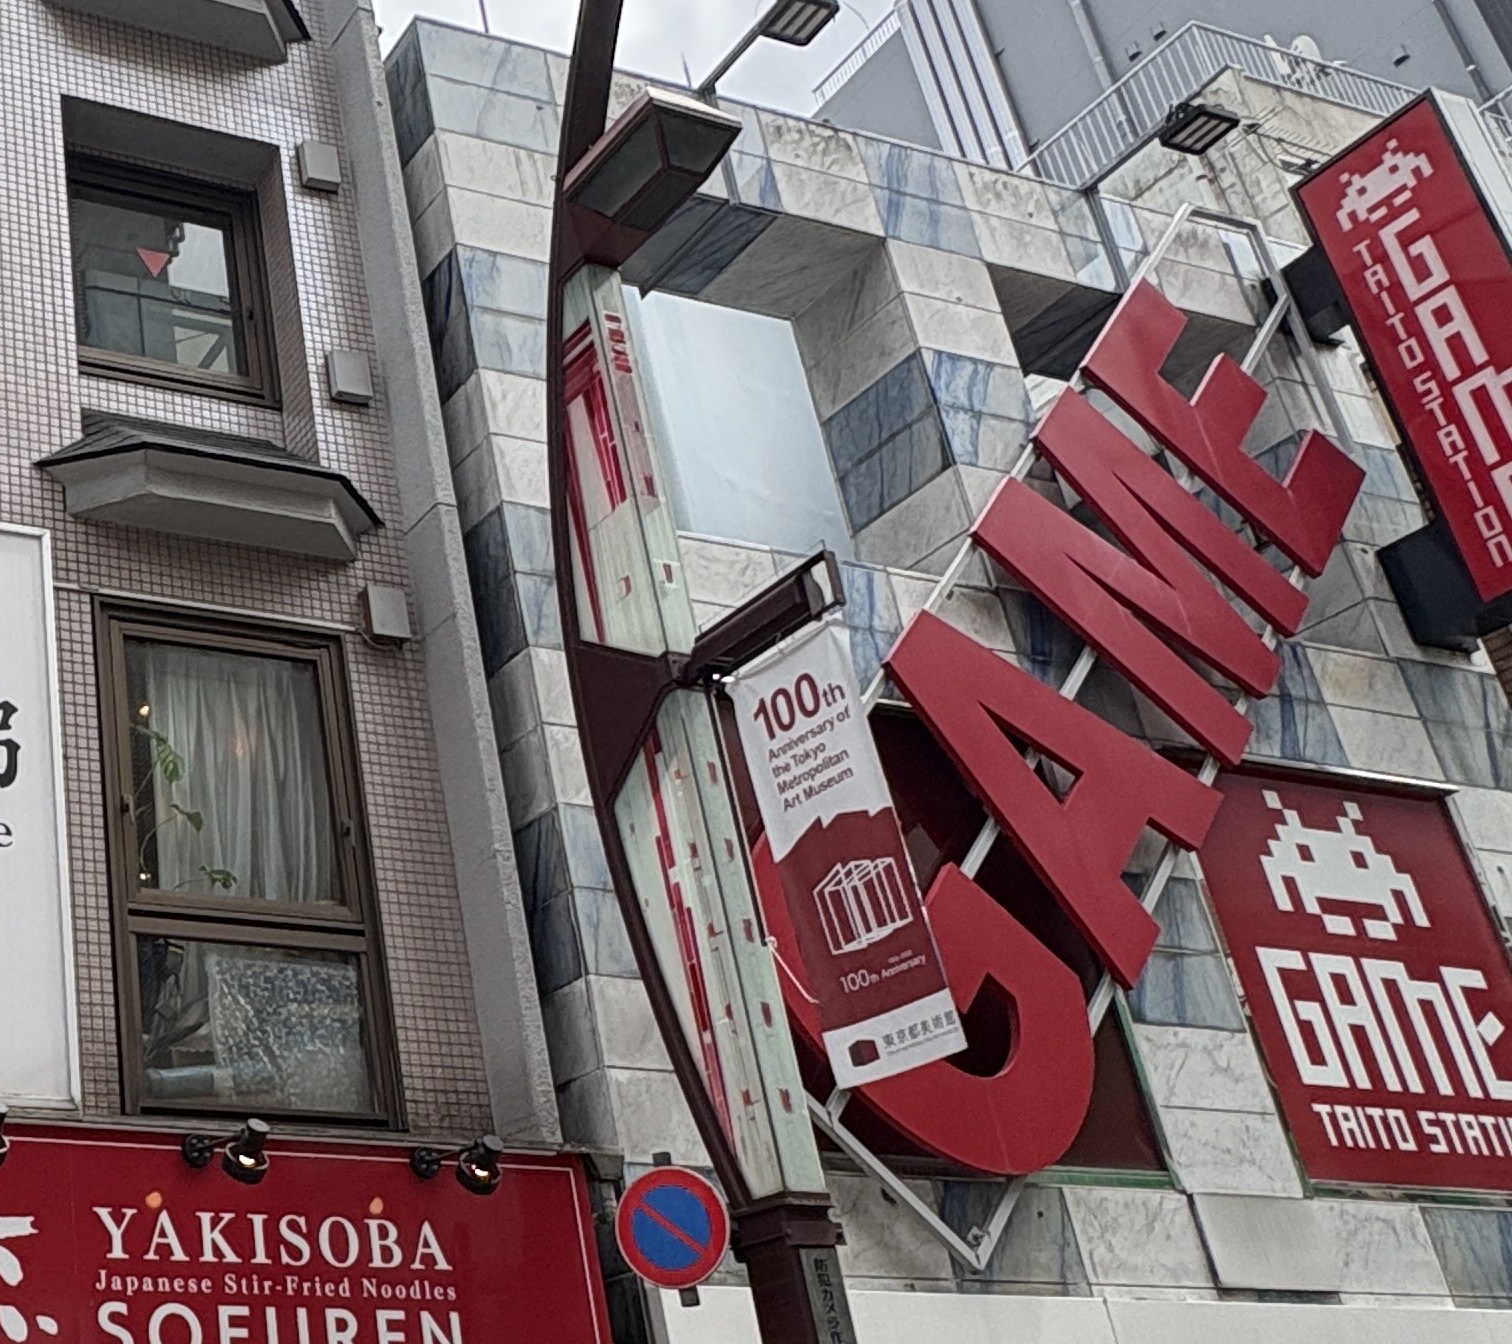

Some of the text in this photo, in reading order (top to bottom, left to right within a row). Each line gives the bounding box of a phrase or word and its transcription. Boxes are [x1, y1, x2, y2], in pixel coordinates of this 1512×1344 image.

[1352, 239, 1512, 568] TAITO STATION
[753, 672, 846, 741] 100th
[768, 706, 851, 763] Anniversary of
[772, 741, 828, 780] the Tokyo
[776, 748, 850, 798] Metropolitan
[782, 766, 854, 813] Art Museum
[1311, 1102, 1512, 1157] TAITO STATI
[92, 1206, 454, 1271] YAKISOBA
[94, 1269, 458, 1301] Japanese Stir-Fried Noodles
